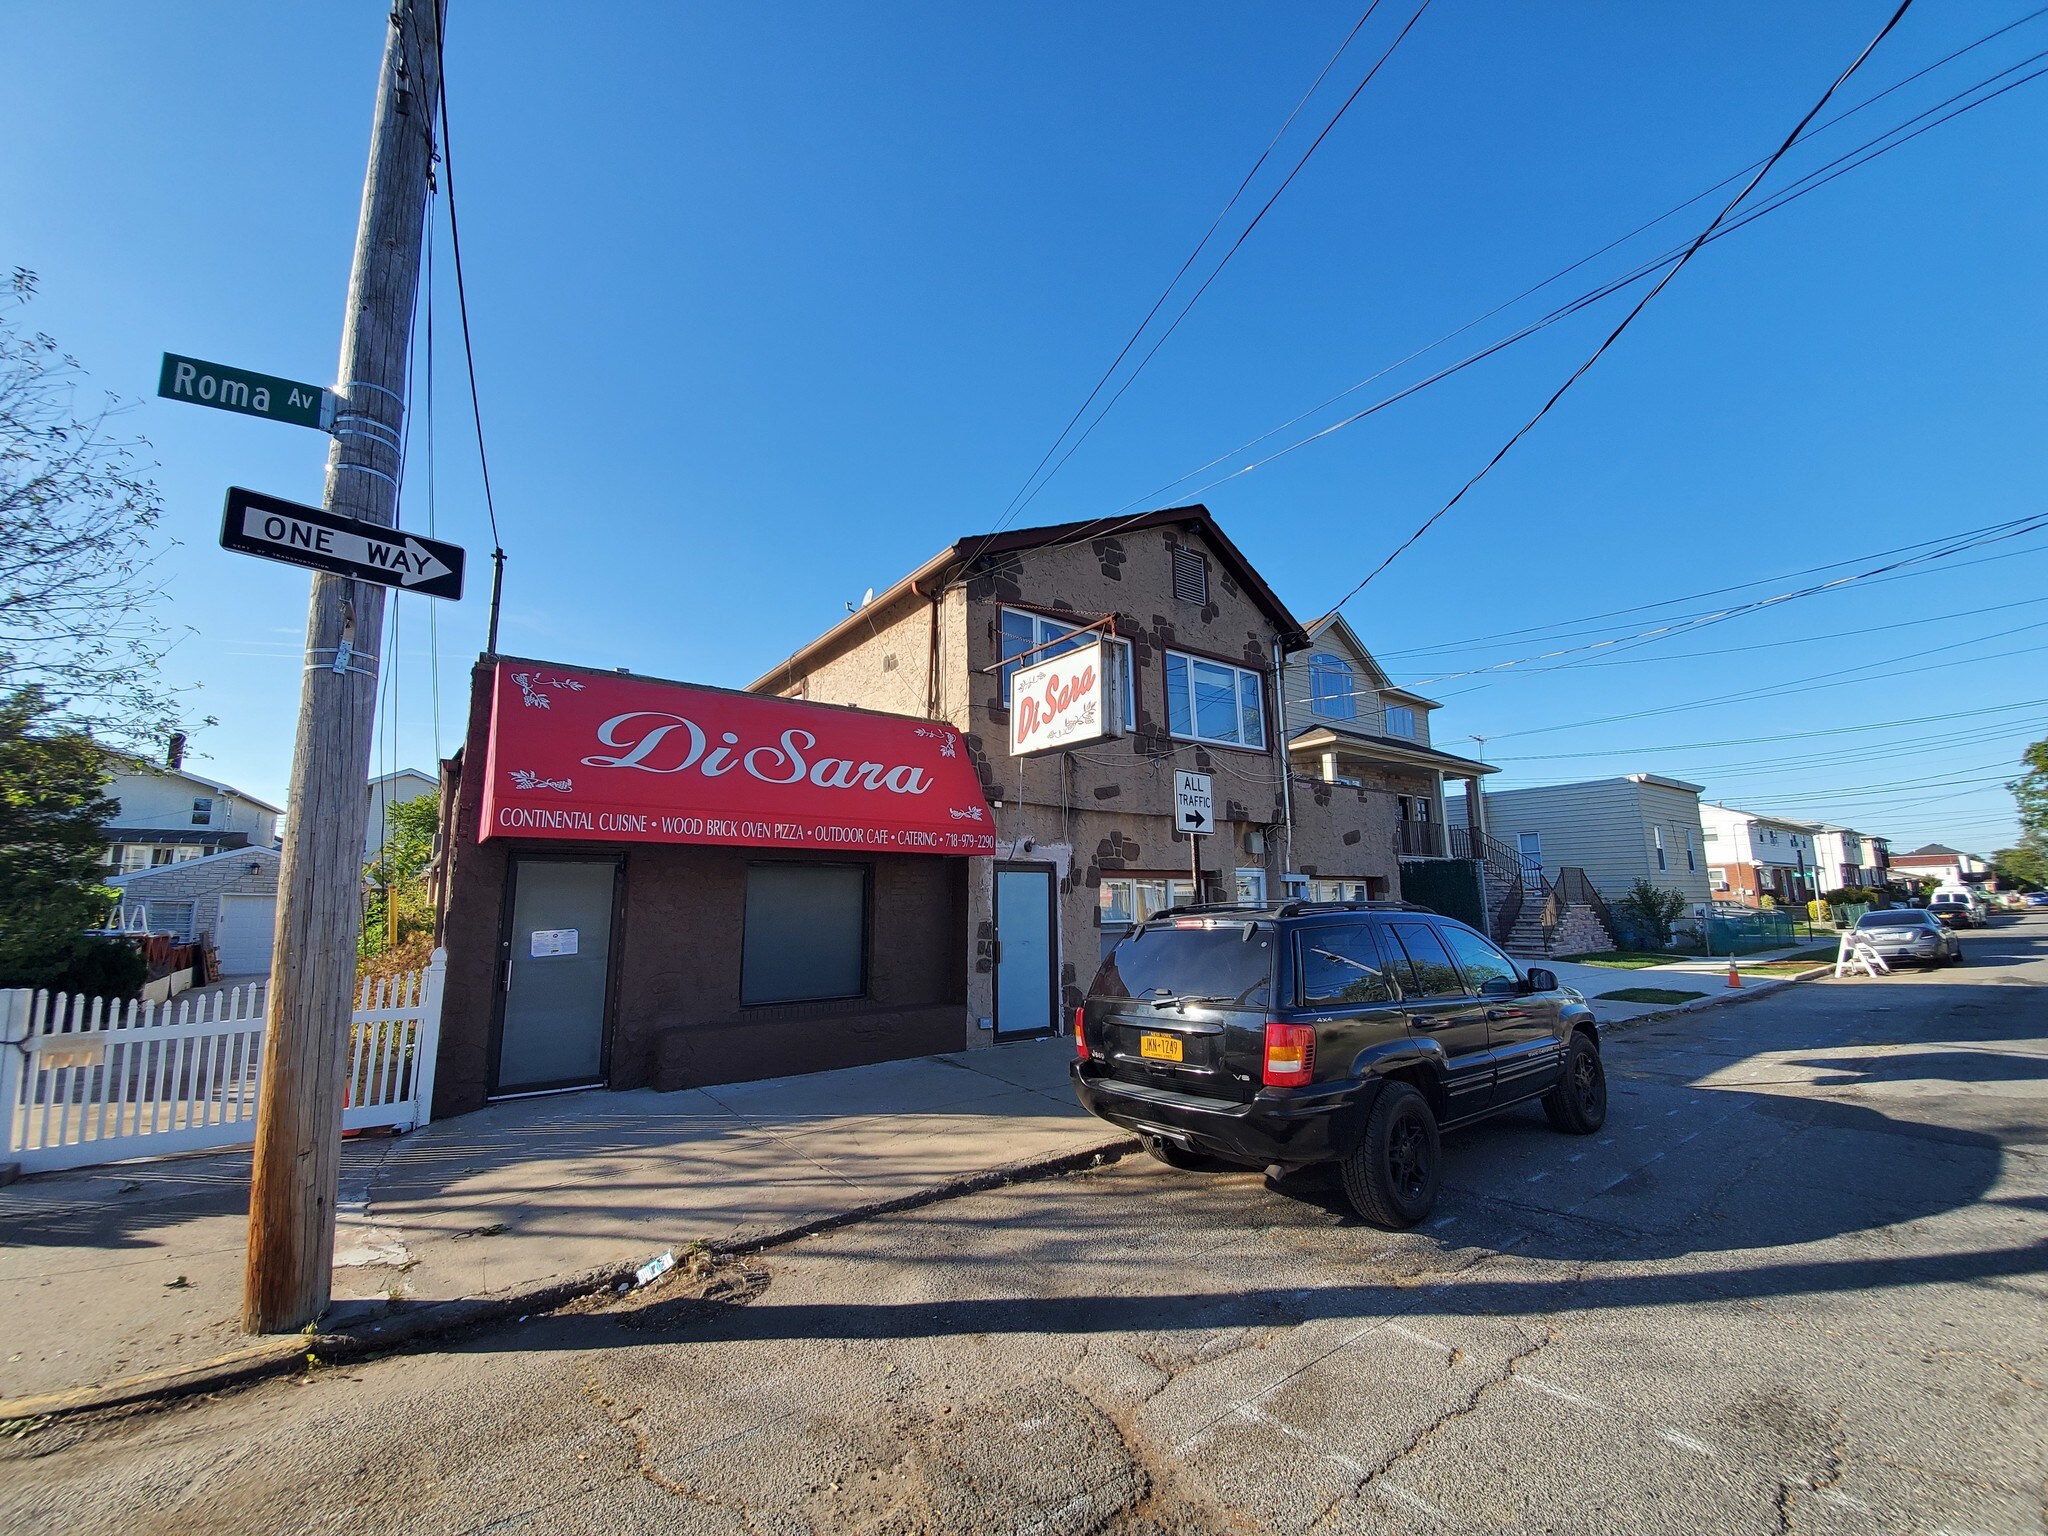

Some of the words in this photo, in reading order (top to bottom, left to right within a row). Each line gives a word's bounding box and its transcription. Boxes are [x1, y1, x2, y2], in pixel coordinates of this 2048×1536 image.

[173, 361, 271, 413] Roma
[287, 386, 313, 409] Av
[264, 516, 335, 554] ONE
[367, 541, 432, 576] WAY
[1179, 793, 1211, 809] TRAFFIC
[1184, 776, 1204, 792] ALL
[499, 807, 595, 831] CONTINENTAL
[599, 812, 648, 833] CUISINE
[661, 816, 703, 835] WOOD
[706, 819, 738, 837] BRICK
[741, 821, 771, 838] OVEN
[774, 823, 804, 840] PIZZA
[814, 825, 864, 843] OUTDOOR
[866, 828, 888, 844] CAFE
[898, 830, 937, 847] CATERING
[945, 833, 994, 849] 718-979-2290
